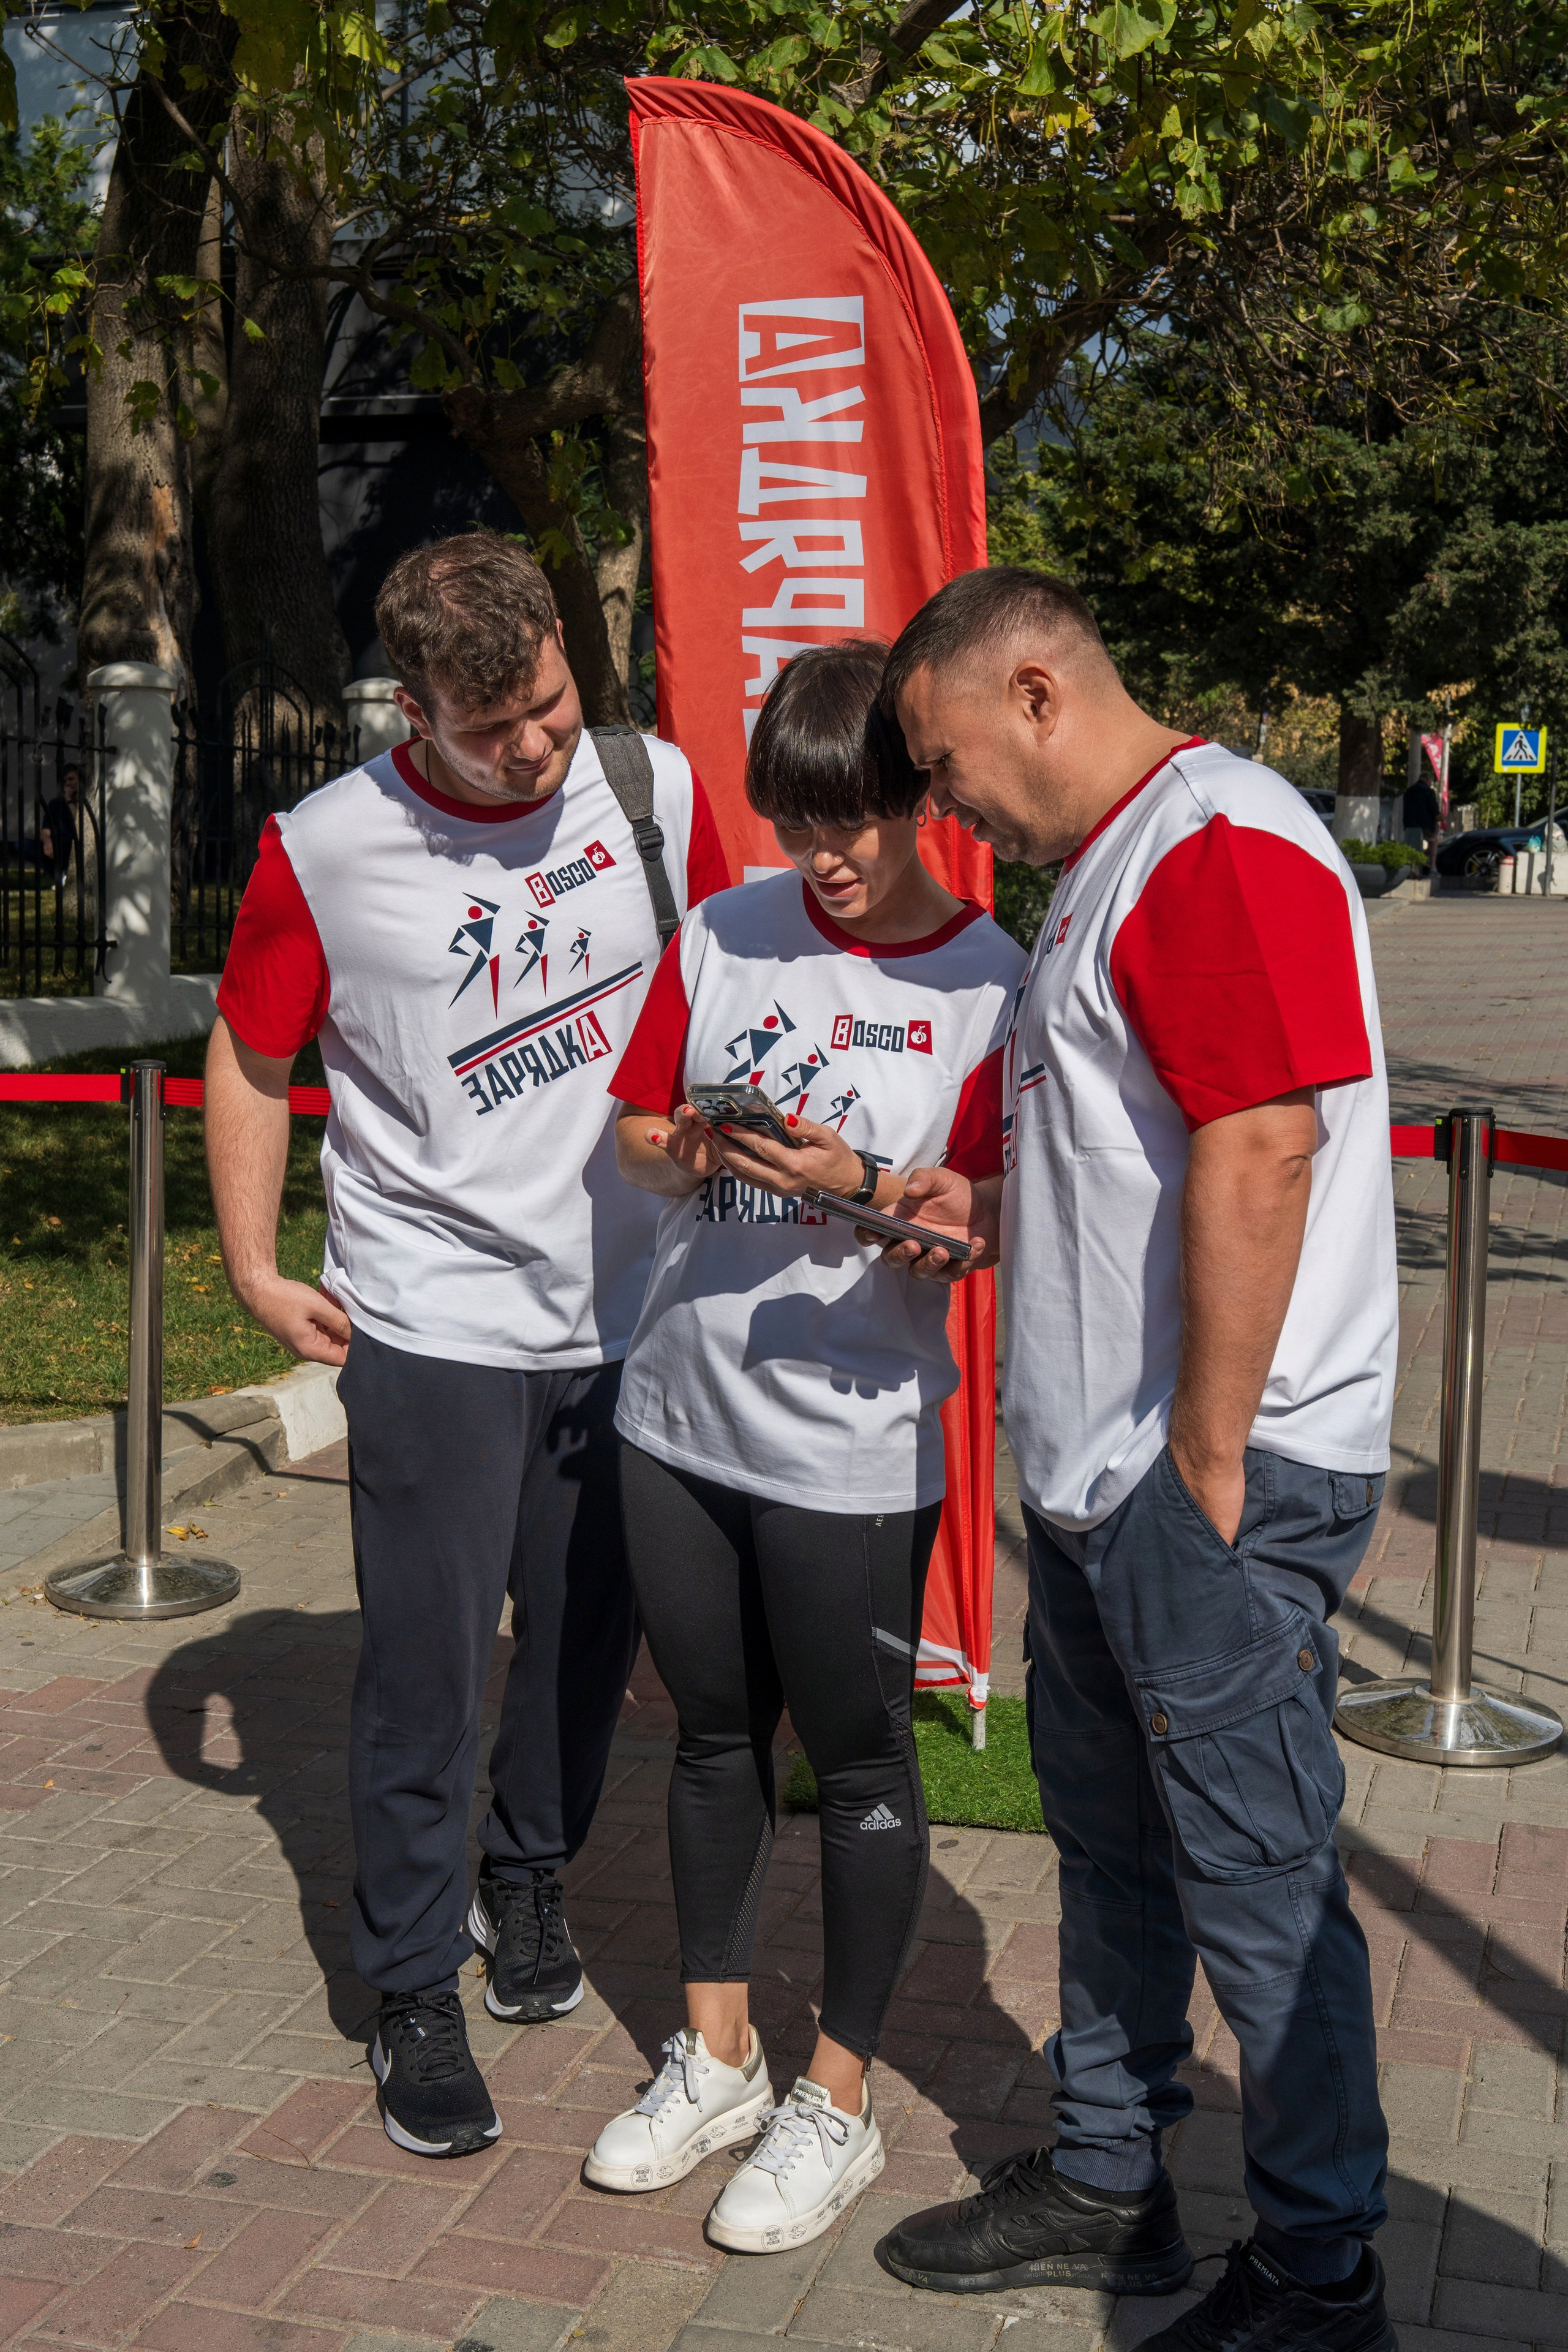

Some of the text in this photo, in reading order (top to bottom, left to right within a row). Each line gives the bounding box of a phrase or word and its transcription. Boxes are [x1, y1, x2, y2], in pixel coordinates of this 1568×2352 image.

[461, 1010, 612, 1116] ЗАРЯДКА
[859, 1818, 902, 1830] adidas
[794, 2089, 823, 2105] PREMIATA
[732, 2121, 749, 2130] ORIGINAL
[1250, 2255, 1279, 2285] PREMIATA
